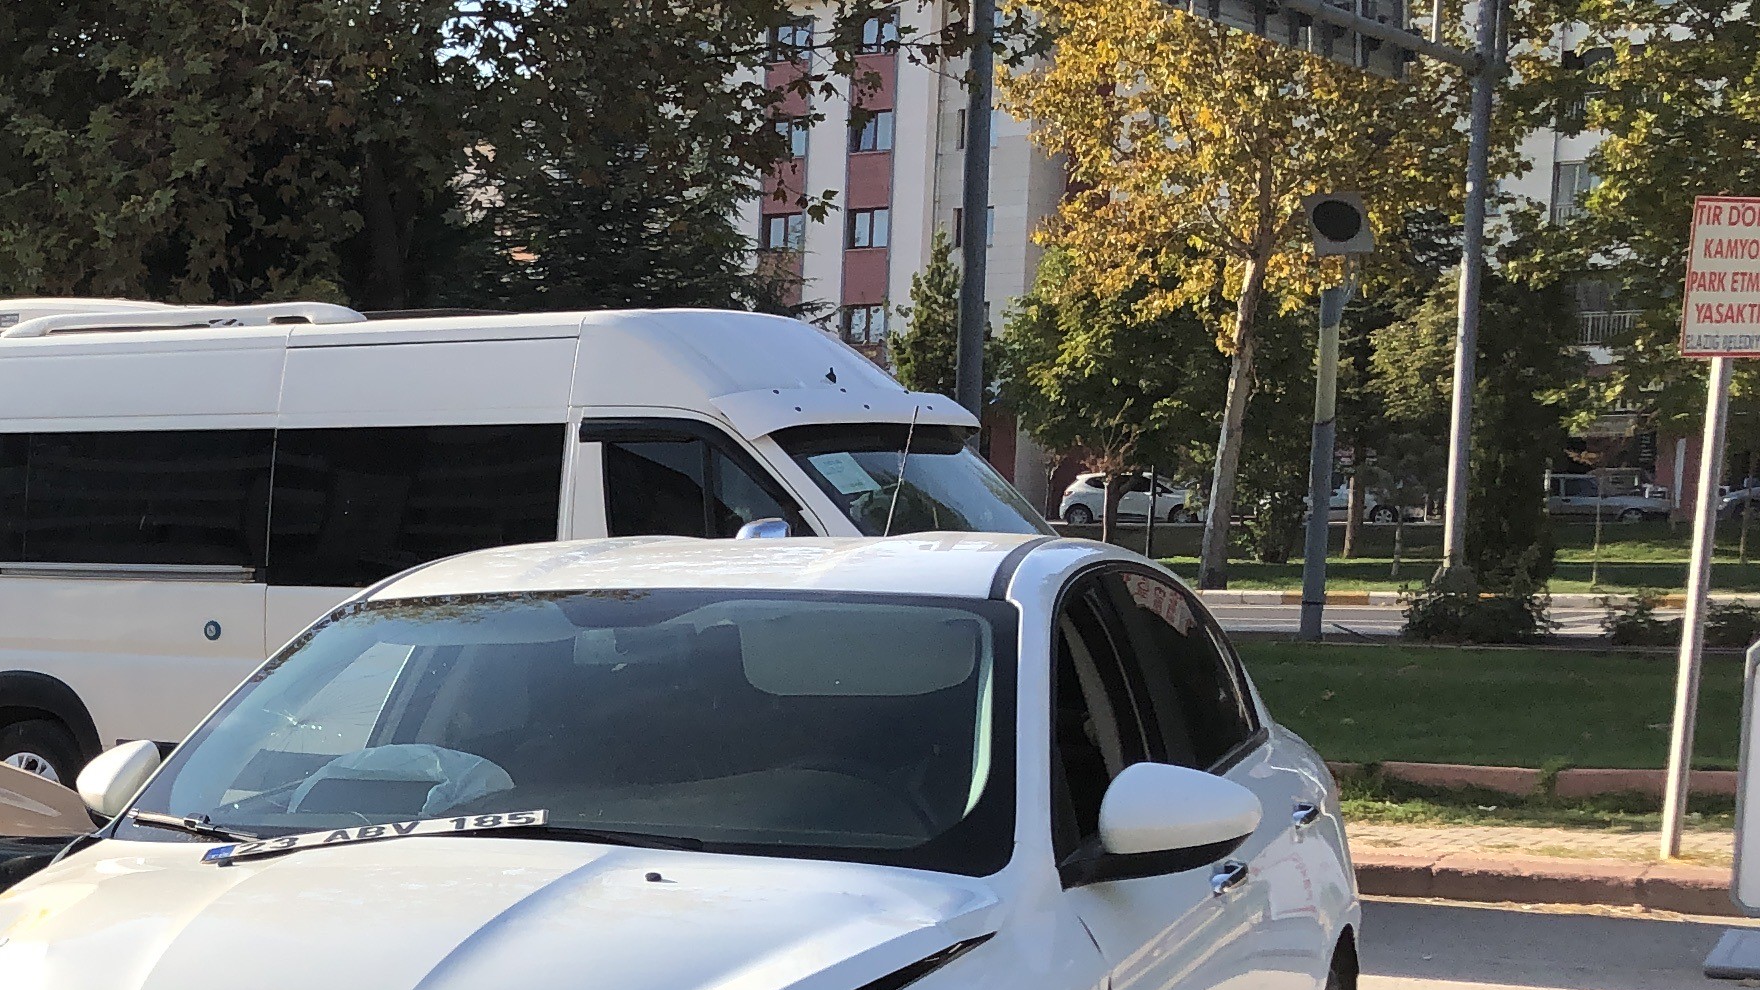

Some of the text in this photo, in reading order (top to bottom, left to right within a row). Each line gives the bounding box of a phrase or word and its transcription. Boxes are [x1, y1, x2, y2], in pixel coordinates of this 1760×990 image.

[1697, 204, 1723, 225] TIR
[1690, 271, 1727, 292] PARK
[237, 811, 536, 855] 23 ABV 185
